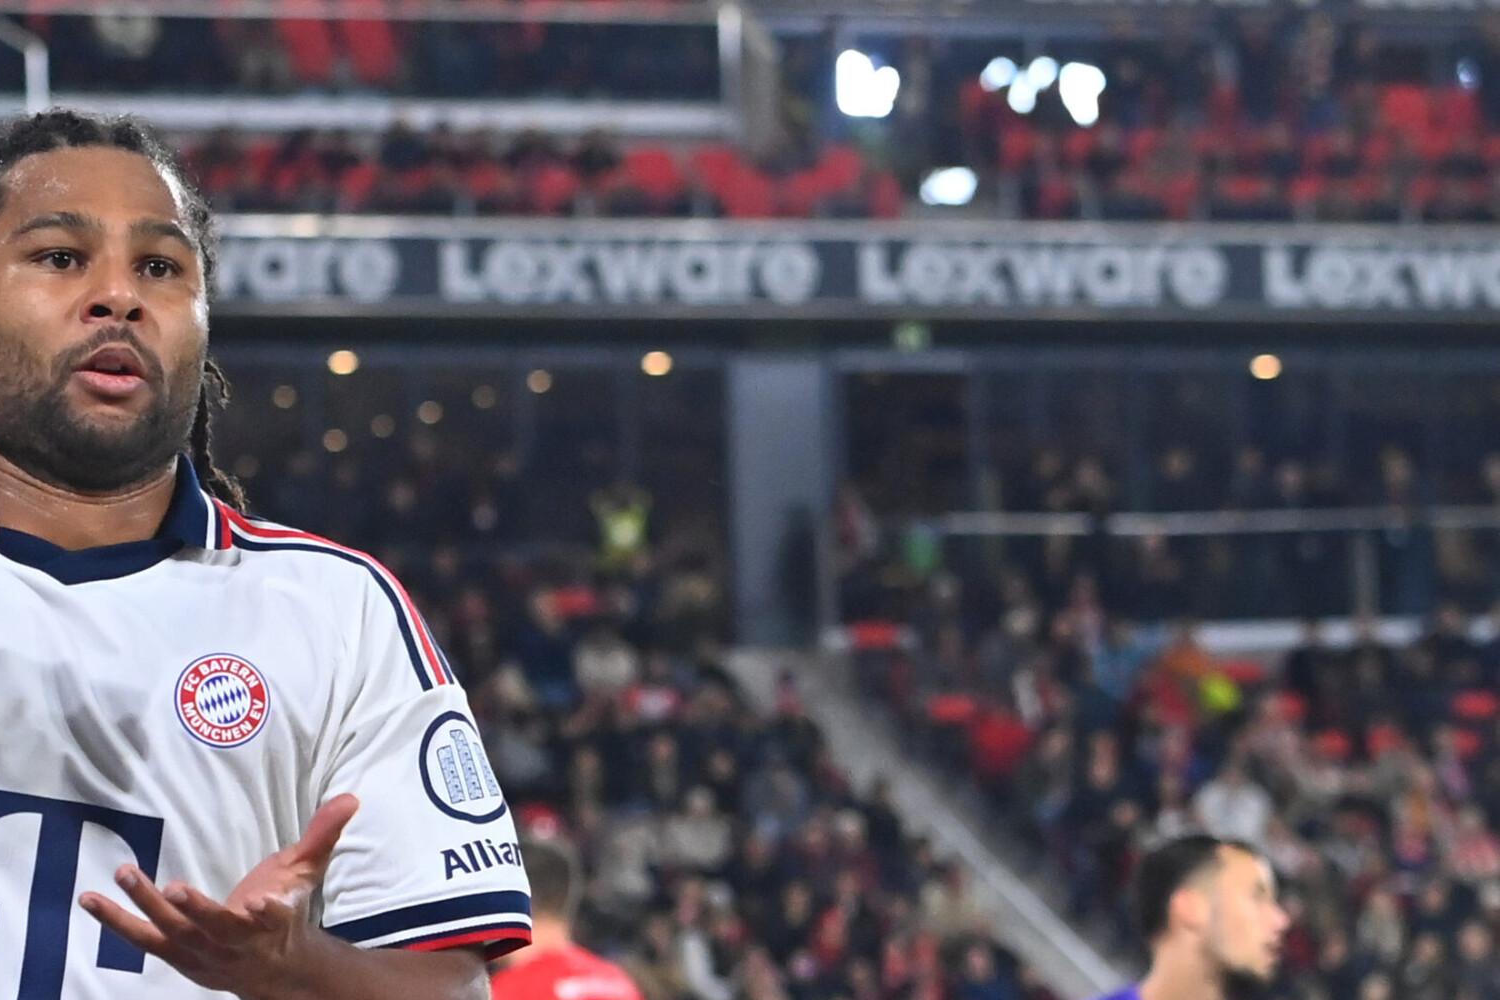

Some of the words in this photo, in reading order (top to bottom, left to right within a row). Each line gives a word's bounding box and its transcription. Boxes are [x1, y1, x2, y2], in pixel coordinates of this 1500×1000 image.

[439, 239, 819, 305] Lexware
[857, 243, 1227, 308] Lexware
[1263, 246, 1500, 308] Lexw
[183, 673, 200, 692] FC
[198, 659, 259, 689] BAYERN
